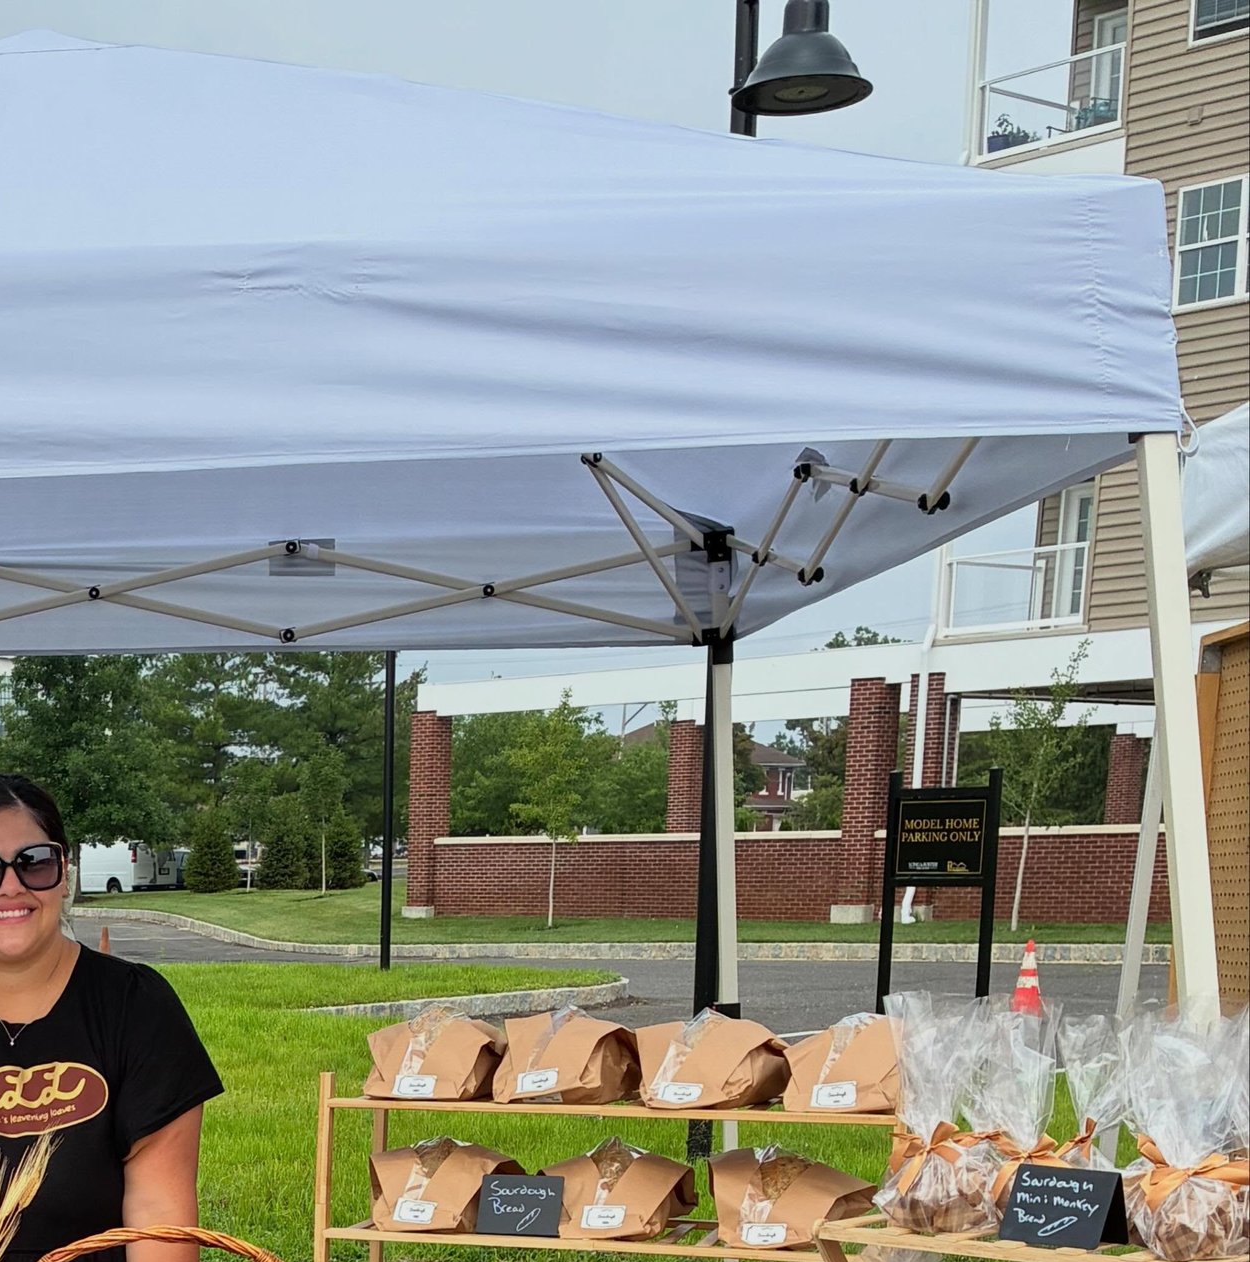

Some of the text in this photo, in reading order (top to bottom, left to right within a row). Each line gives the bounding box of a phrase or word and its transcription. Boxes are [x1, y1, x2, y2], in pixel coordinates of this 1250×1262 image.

[904, 818, 980, 830] MODEL HOME
[901, 831, 982, 843] PARKING ONLY
[10, 1112, 49, 1124] leavening
[50, 1104, 76, 1117] loaves
[490, 1181, 556, 1200] Sourdough
[1021, 1171, 1094, 1193] Sourdough
[488, 1197, 526, 1215] Bread
[1016, 1192, 1048, 1204] Mini
[1013, 1208, 1046, 1224] Bread
